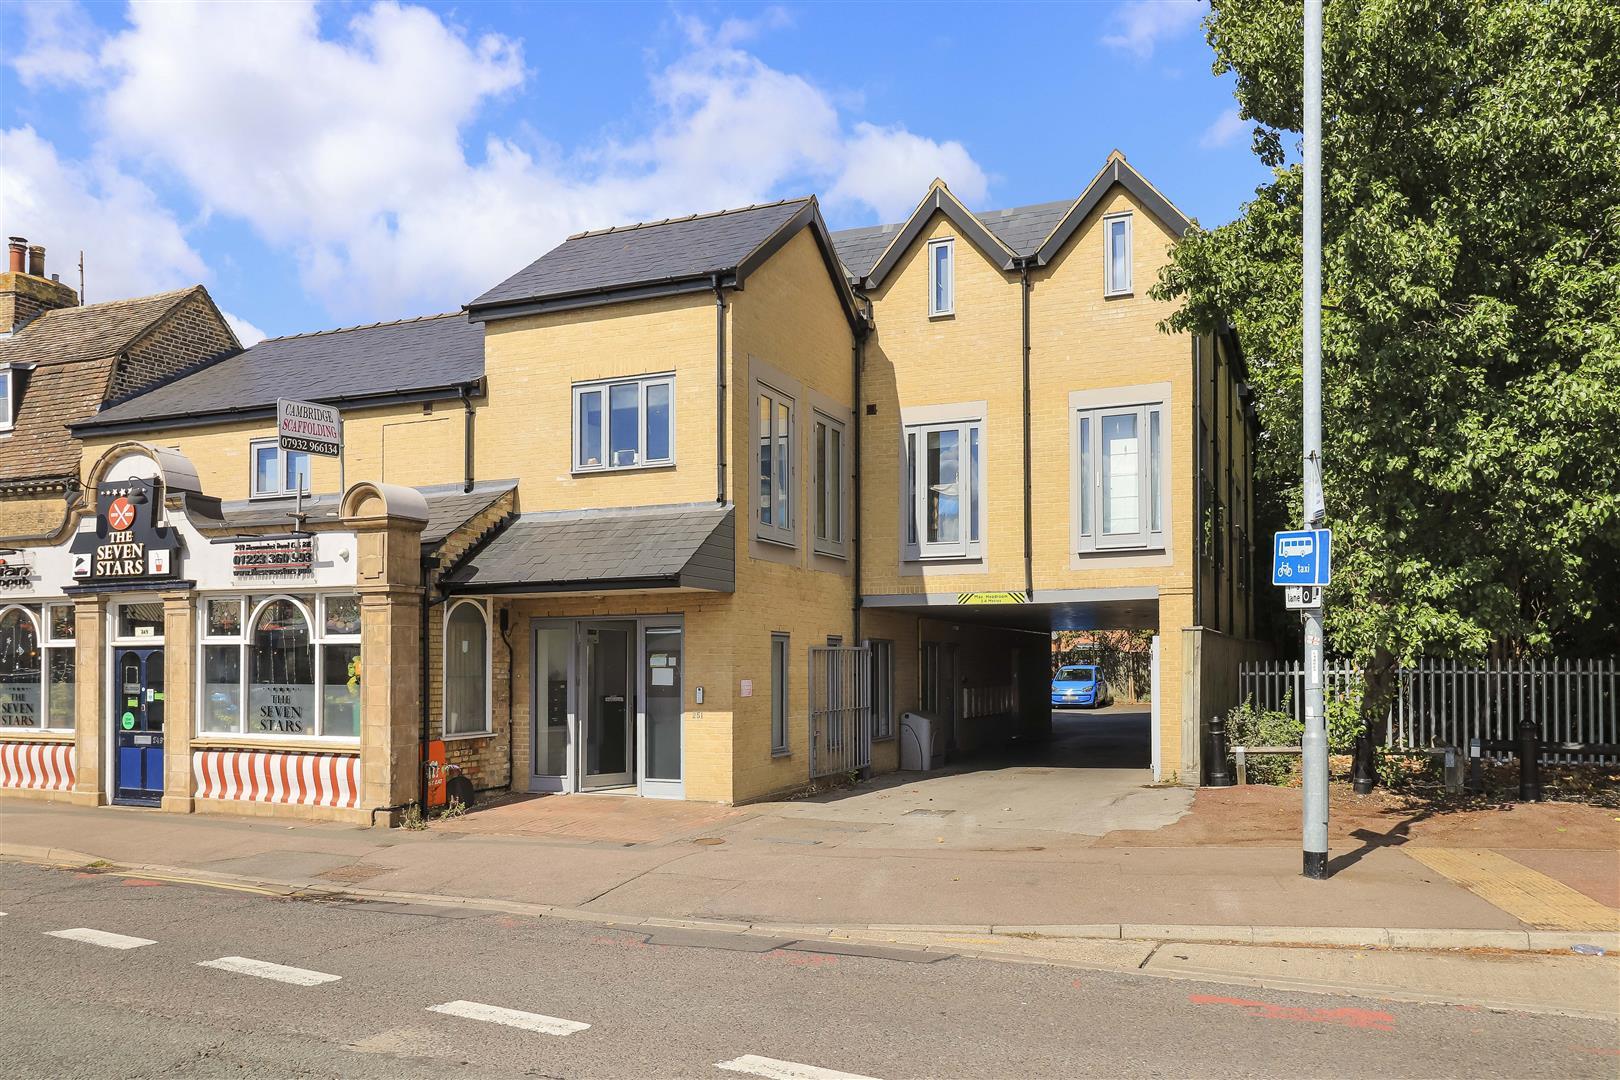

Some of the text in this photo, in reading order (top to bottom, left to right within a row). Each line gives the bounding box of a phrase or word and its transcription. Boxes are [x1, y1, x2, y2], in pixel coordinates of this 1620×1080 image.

[285, 403, 334, 423] CAMBRIDGE
[282, 418, 337, 439] SCAFFOLDING
[281, 437, 308, 450] 07932
[309, 441, 338, 455] 966134
[109, 530, 133, 543] THE
[96, 542, 144, 561] SEVEN
[233, 554, 267, 565] 01223
[268, 553, 290, 564] 360
[96, 559, 144, 576] STARS
[1297, 563, 1310, 574] taxi
[1287, 593, 1301, 603] lane
[11, 693, 26, 702] THE
[271, 694, 291, 704] THE
[1, 702, 34, 714] SEVEN
[260, 705, 303, 719] SEVEN
[1, 714, 35, 726] STARS
[260, 719, 303, 732] STARS
